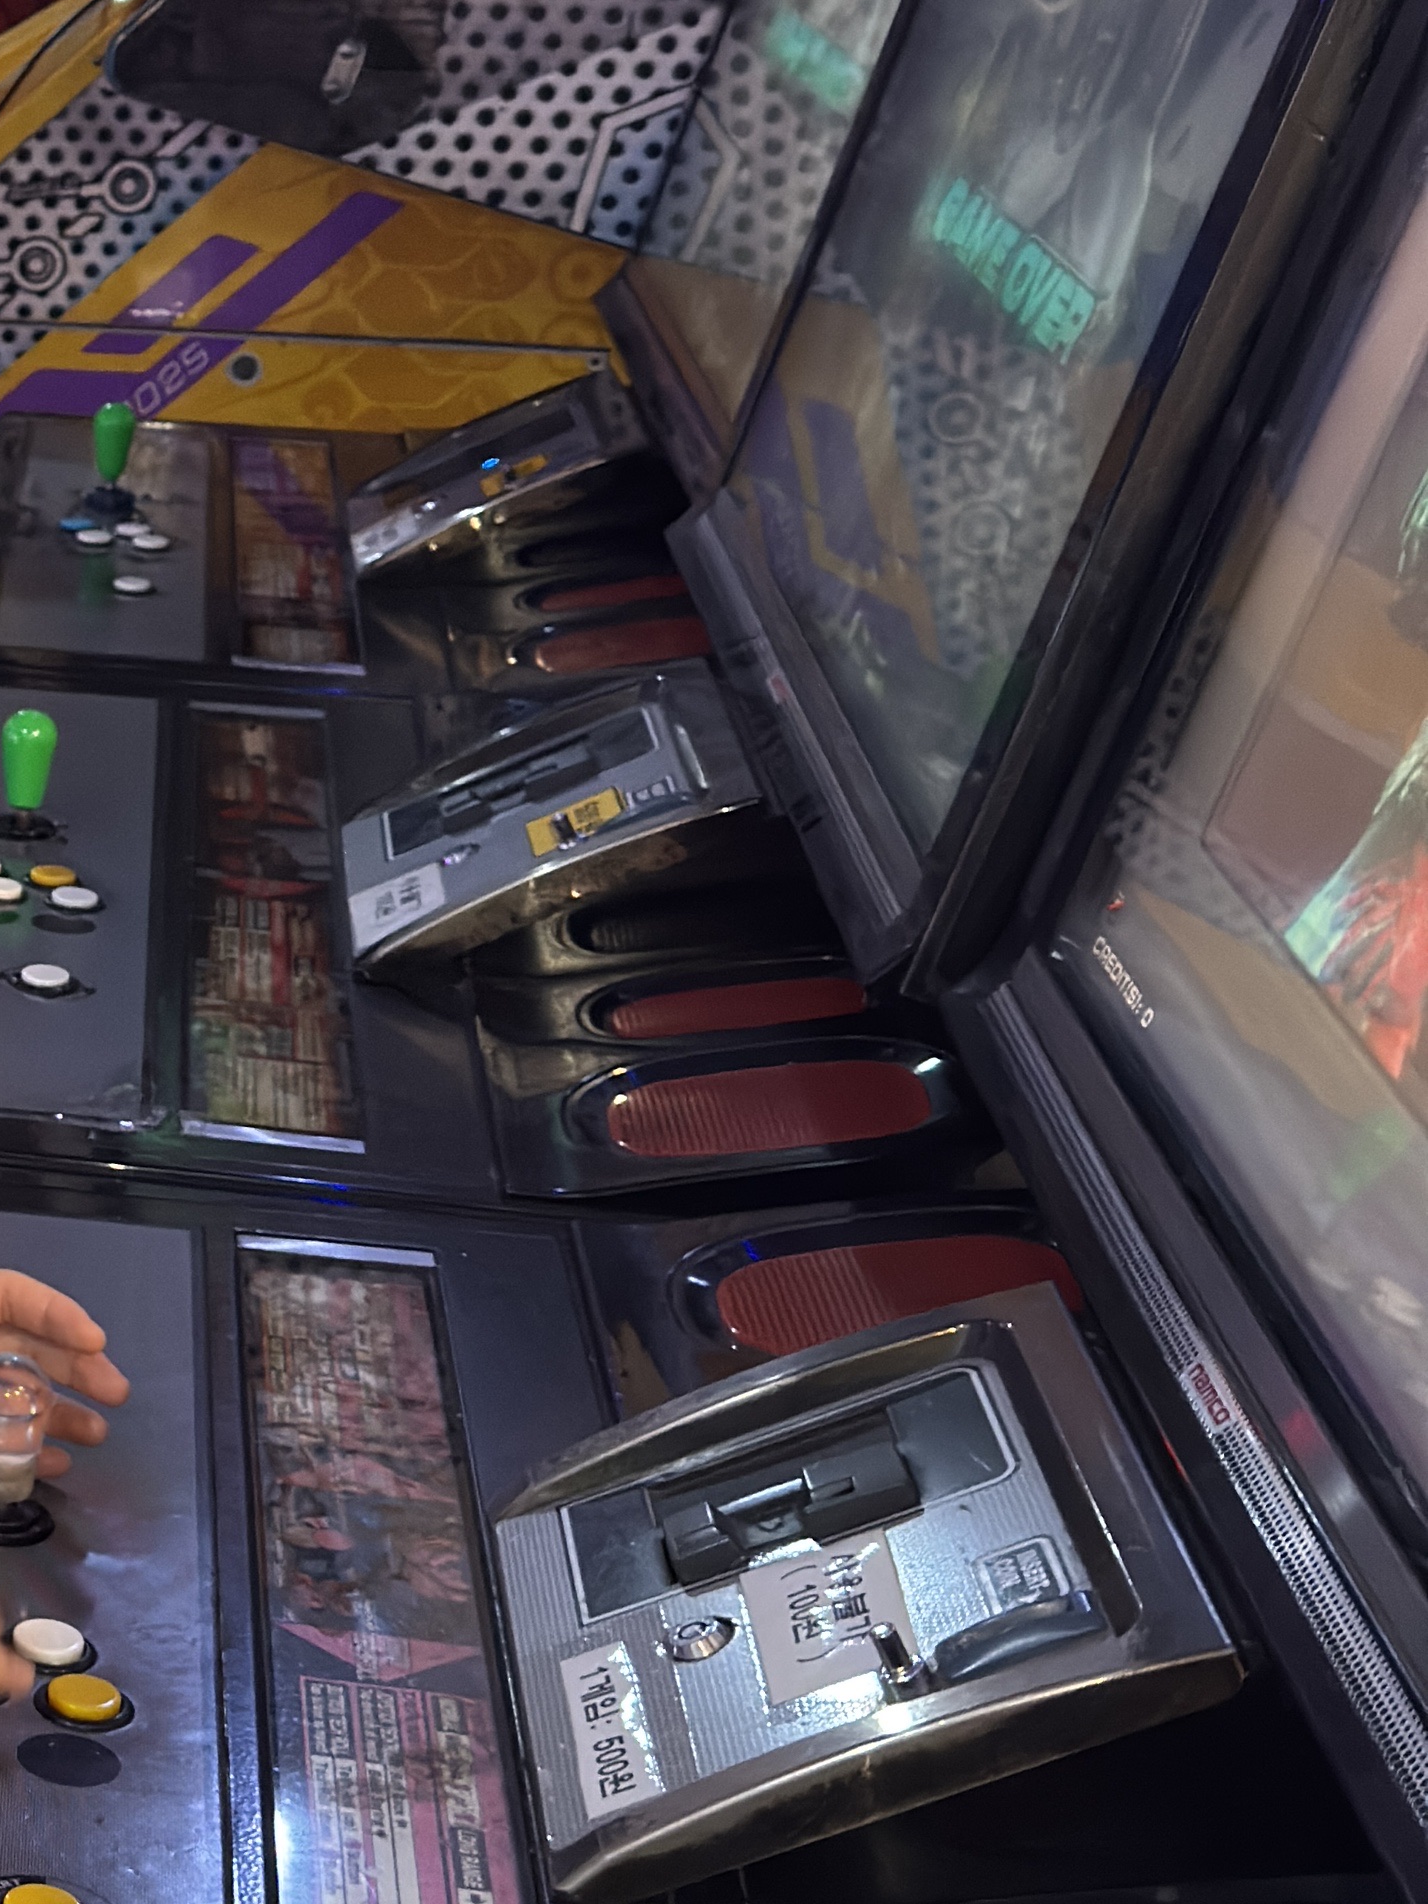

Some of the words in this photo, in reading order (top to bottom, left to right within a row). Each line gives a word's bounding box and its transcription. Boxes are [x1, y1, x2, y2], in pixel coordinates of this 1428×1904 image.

[1001, 241, 1096, 366] OVER
[1187, 1362, 1231, 1427] namco
[578, 1665, 621, 1731] 1게임:
[592, 1734, 638, 1799] 500원
[460, 1856, 484, 1889] RANGE
